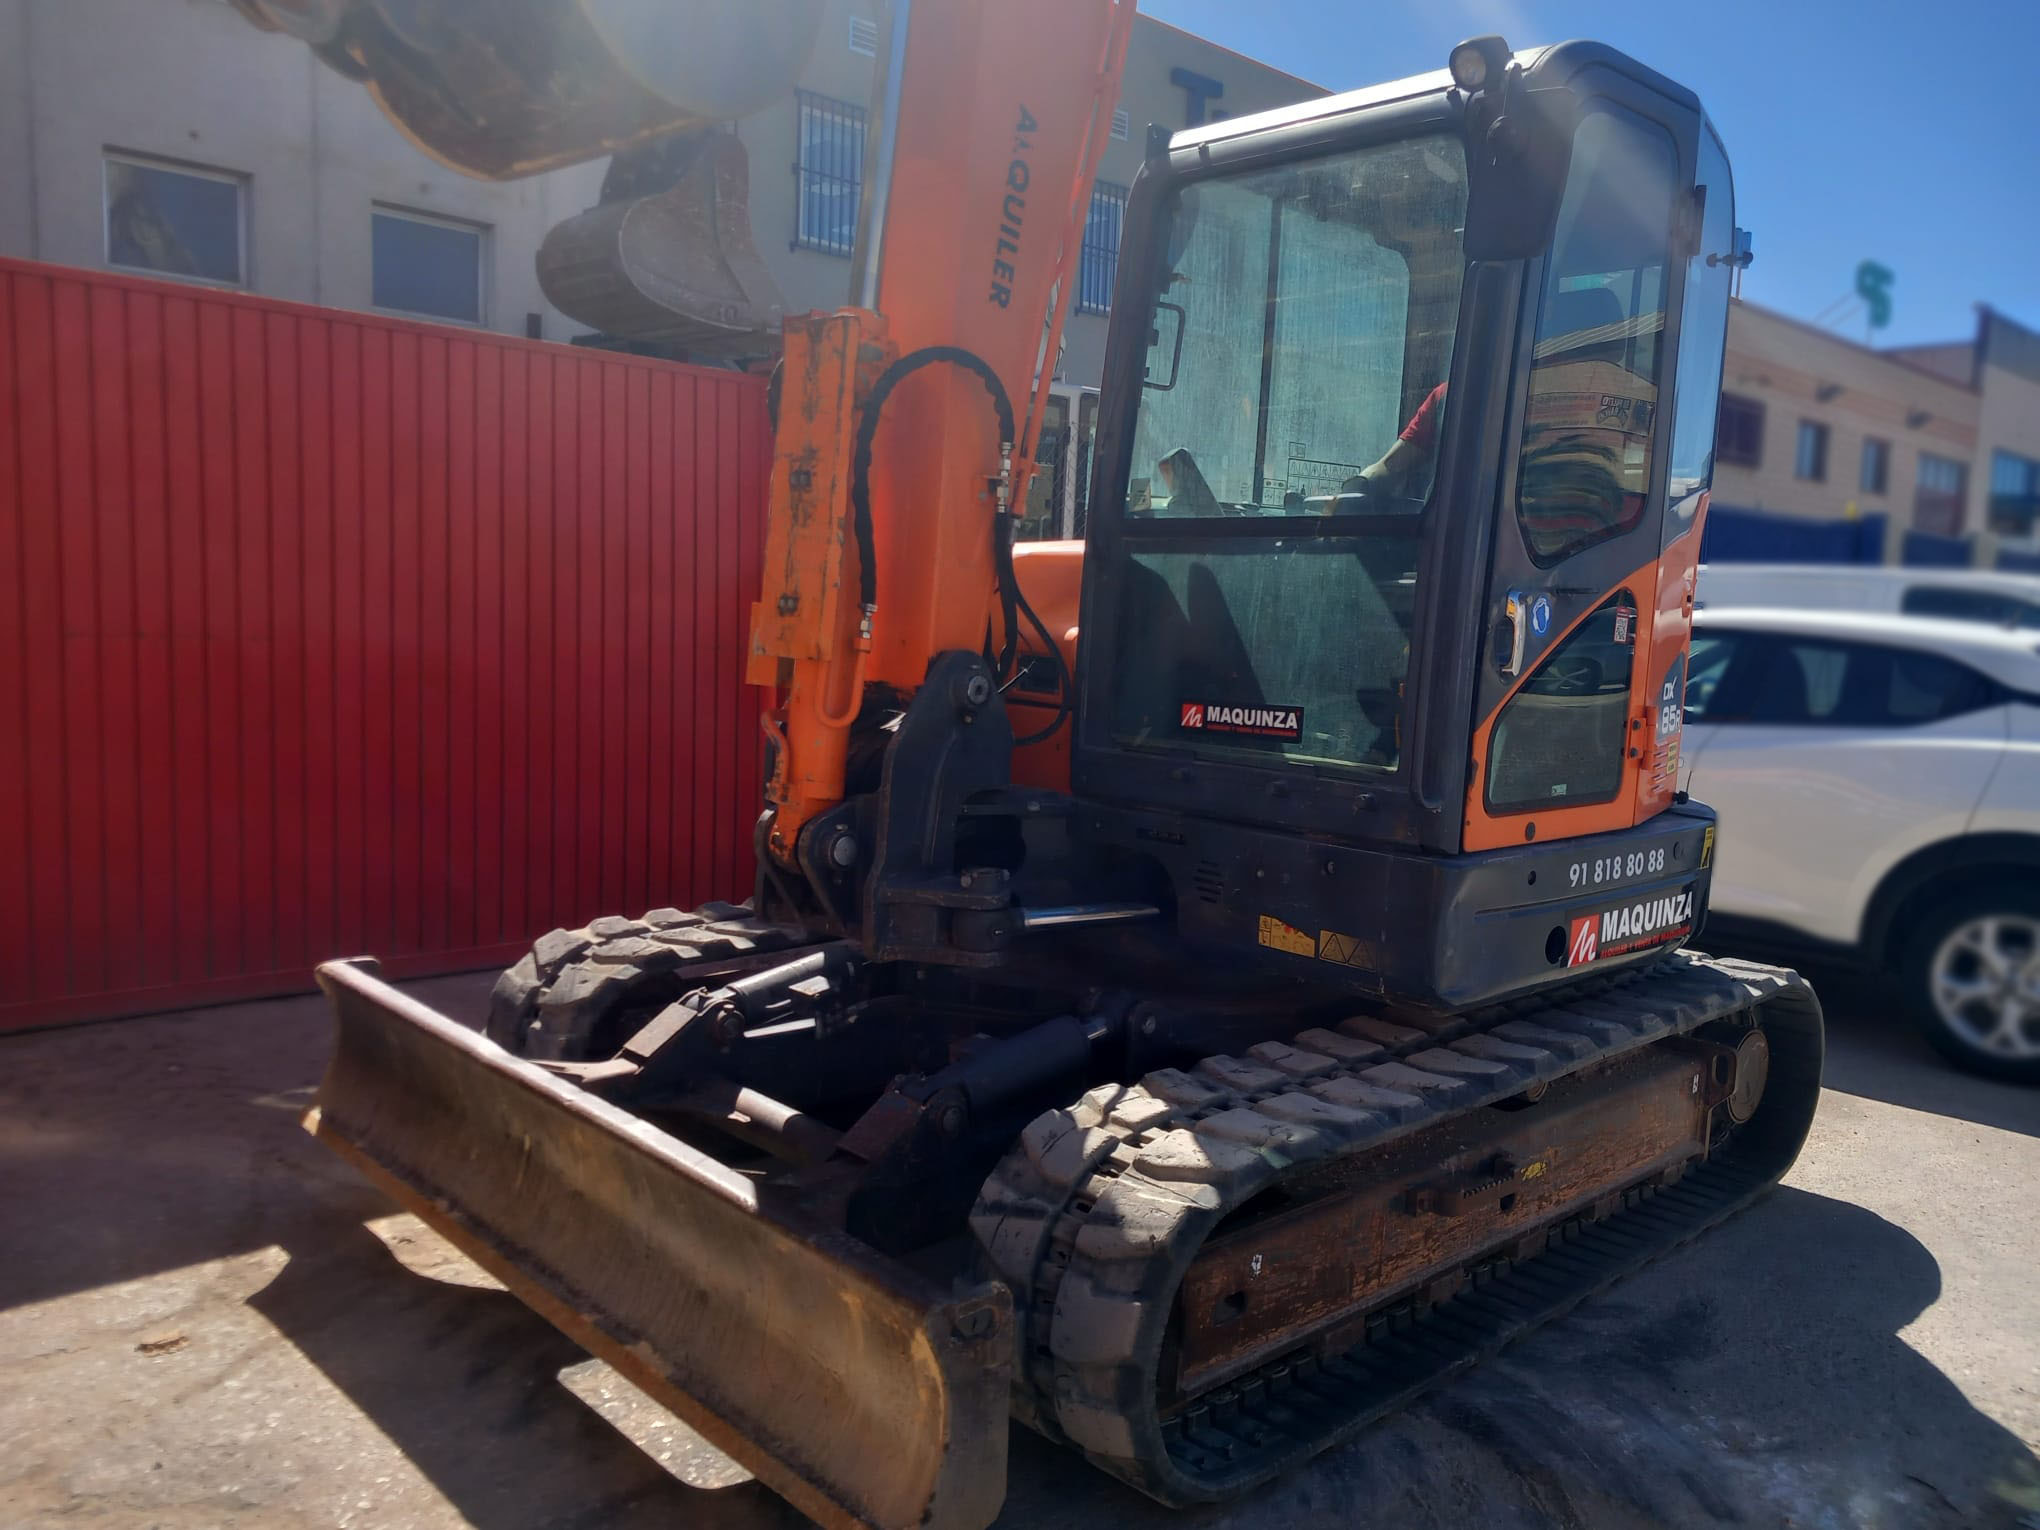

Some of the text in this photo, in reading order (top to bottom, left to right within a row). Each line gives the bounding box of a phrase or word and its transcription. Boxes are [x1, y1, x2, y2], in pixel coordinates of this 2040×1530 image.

[1207, 705, 1298, 729] MAQUINZA
[1569, 848, 1665, 887] 91 818 80 88
[1601, 891, 1693, 944] MAQUINZA
